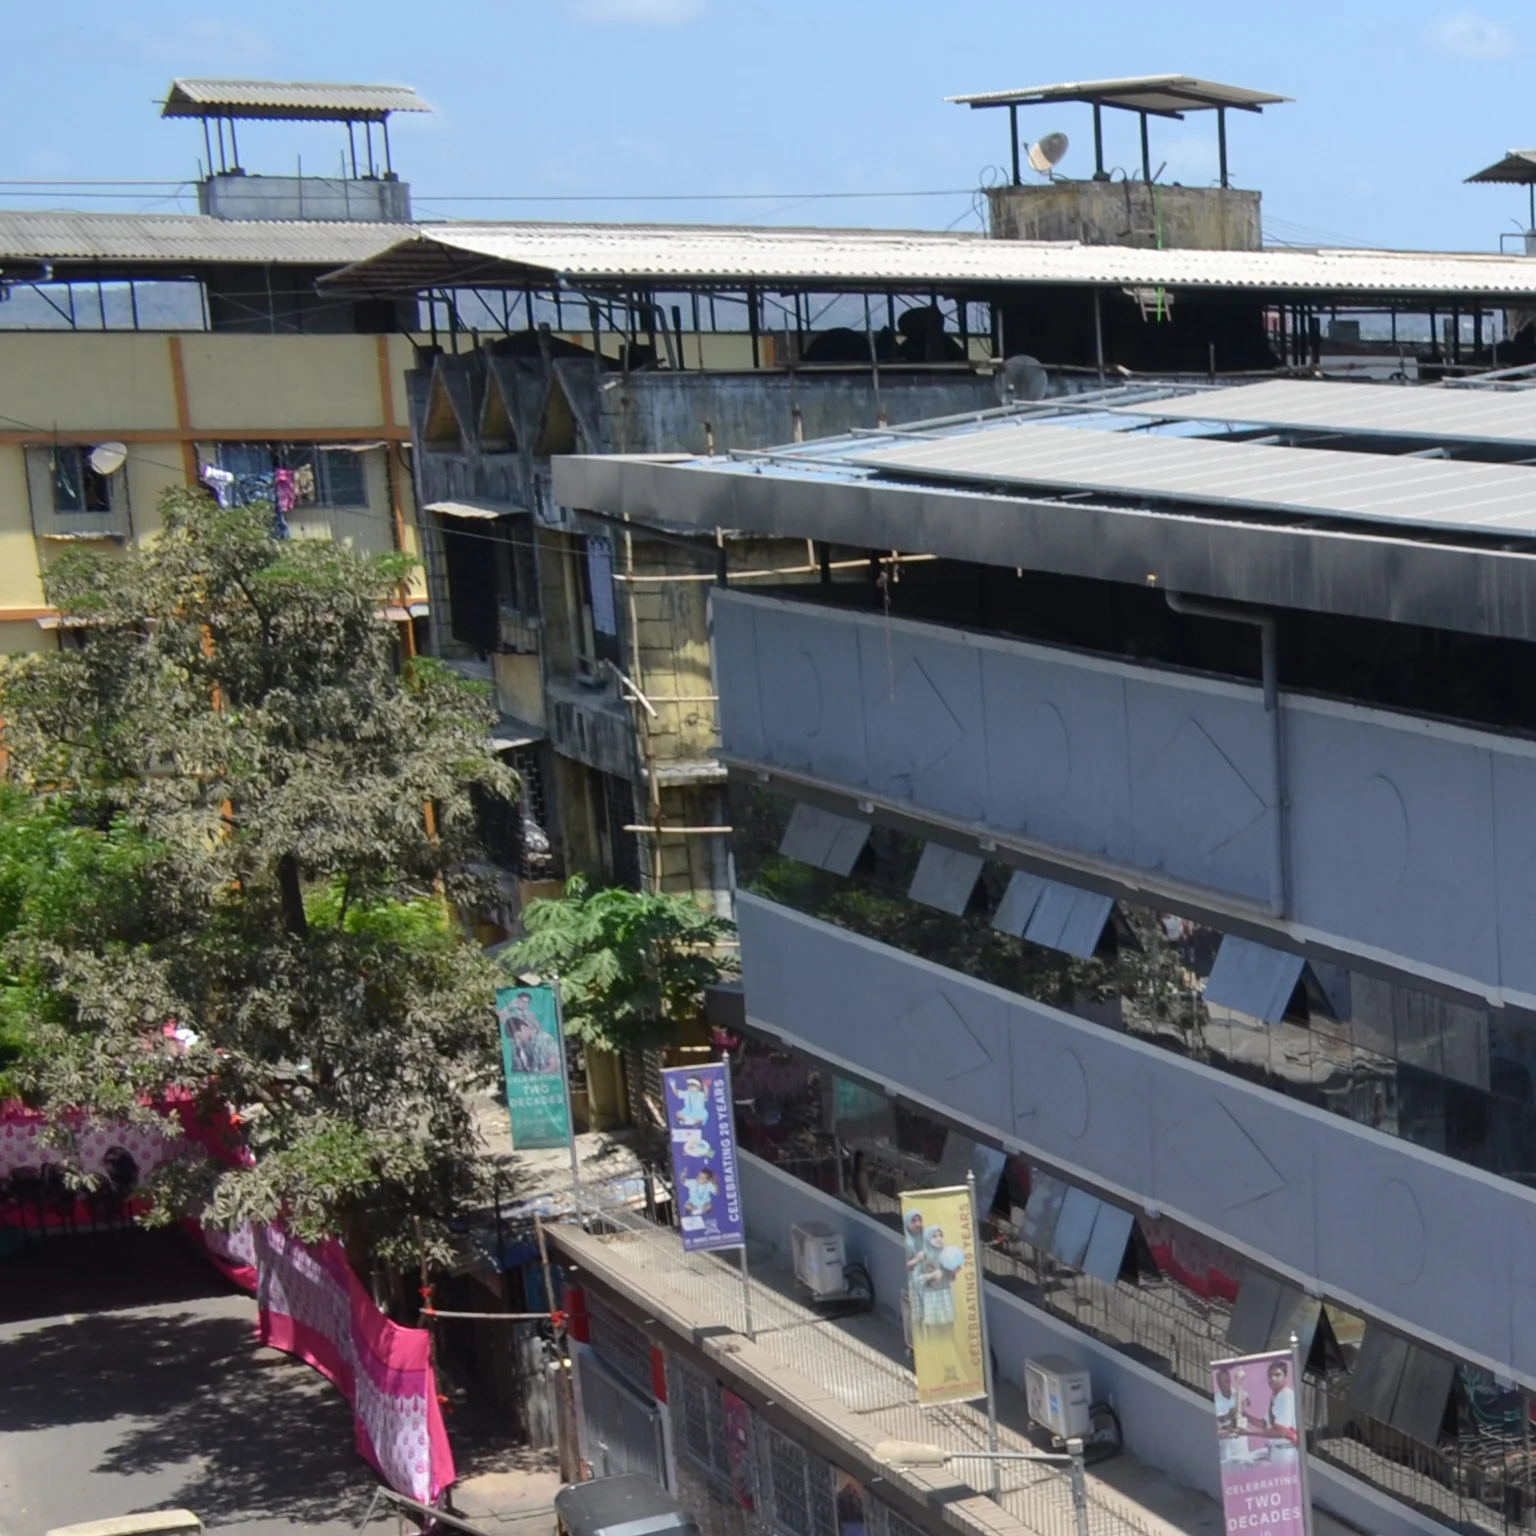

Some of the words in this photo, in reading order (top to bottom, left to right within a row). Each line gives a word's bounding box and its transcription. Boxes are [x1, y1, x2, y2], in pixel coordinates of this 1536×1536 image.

[714, 1078, 728, 1121] YEARS
[721, 1138, 739, 1222] CELEBRATING
[959, 1203, 970, 1249] YEARS
[965, 1273, 981, 1367] CELEBRATING
[1226, 1475, 1299, 1495] CELEBRATING
[1245, 1492, 1281, 1511] TWO
[1228, 1507, 1301, 1531] DECADES
